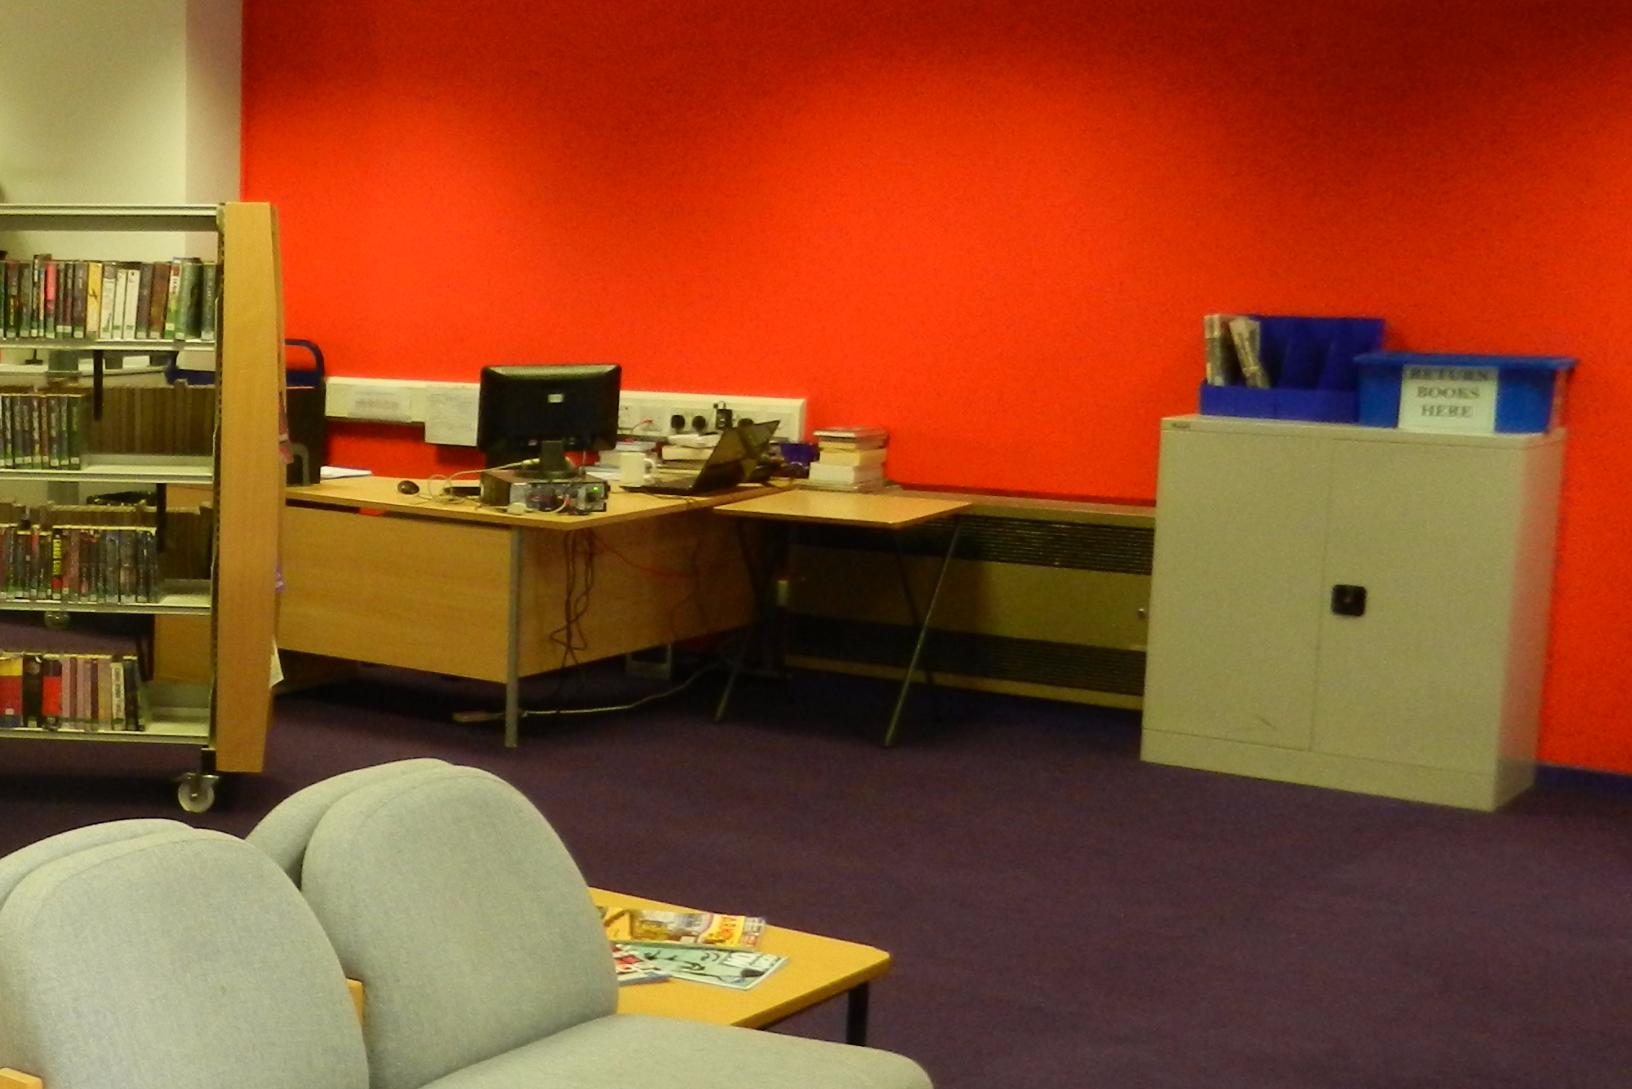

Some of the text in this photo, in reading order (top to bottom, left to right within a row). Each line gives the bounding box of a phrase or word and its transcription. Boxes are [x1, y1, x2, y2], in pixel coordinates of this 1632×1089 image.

[1409, 367, 1488, 381] RETURN
[1416, 386, 1481, 400] BOOKS
[1421, 404, 1473, 418] HERE
